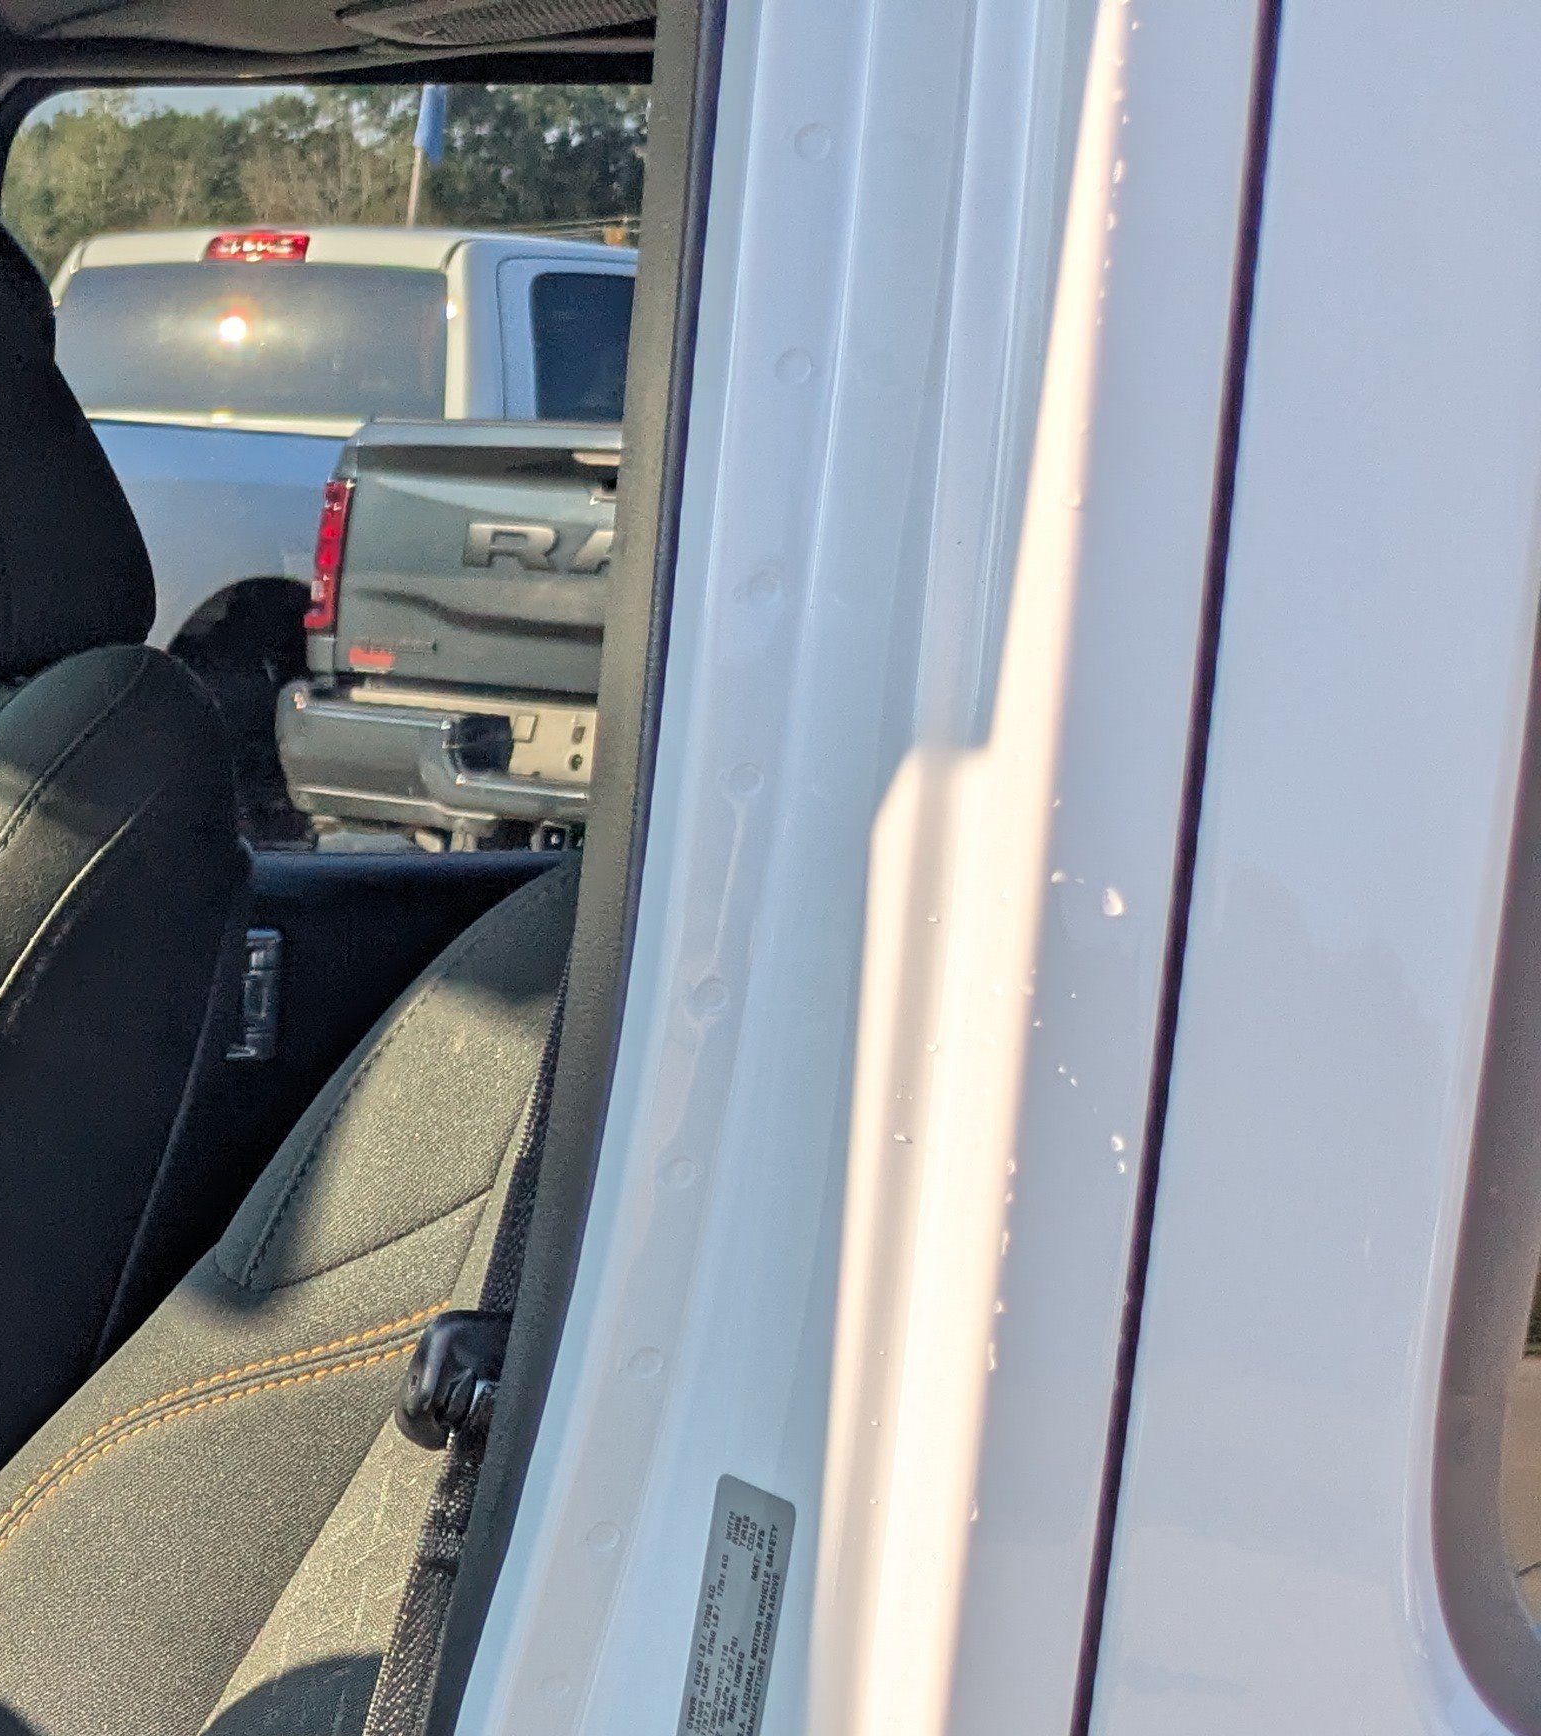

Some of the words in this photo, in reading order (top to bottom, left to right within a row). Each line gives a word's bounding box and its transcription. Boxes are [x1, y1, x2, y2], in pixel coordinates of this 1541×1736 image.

[740, 1662, 756, 1715] FEDERAL
[748, 1619, 763, 1661] MOTOR
[756, 1569, 772, 1618] VEHICLE
[764, 1523, 780, 1569] SAFETY
[759, 1610, 774, 1655] SHOWN
[767, 1571, 781, 1611] ABOVE
